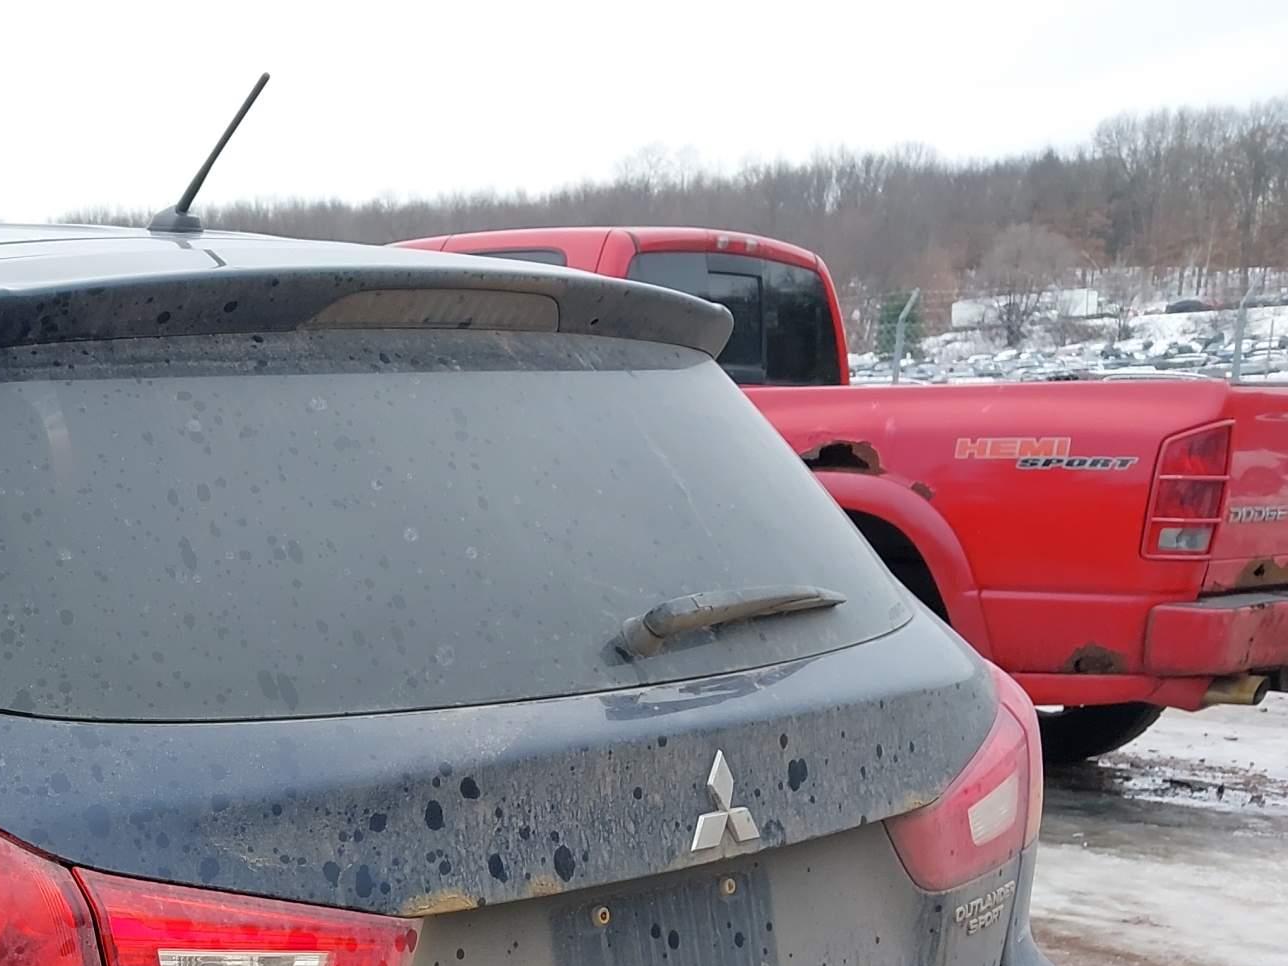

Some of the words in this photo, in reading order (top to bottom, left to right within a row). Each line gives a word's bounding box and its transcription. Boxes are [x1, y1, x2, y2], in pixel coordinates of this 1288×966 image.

[955, 437, 1071, 459] HEMI
[1016, 456, 1139, 469] SPORT
[956, 881, 1015, 922] OUTLANDER
[968, 905, 1004, 935] SPORT
